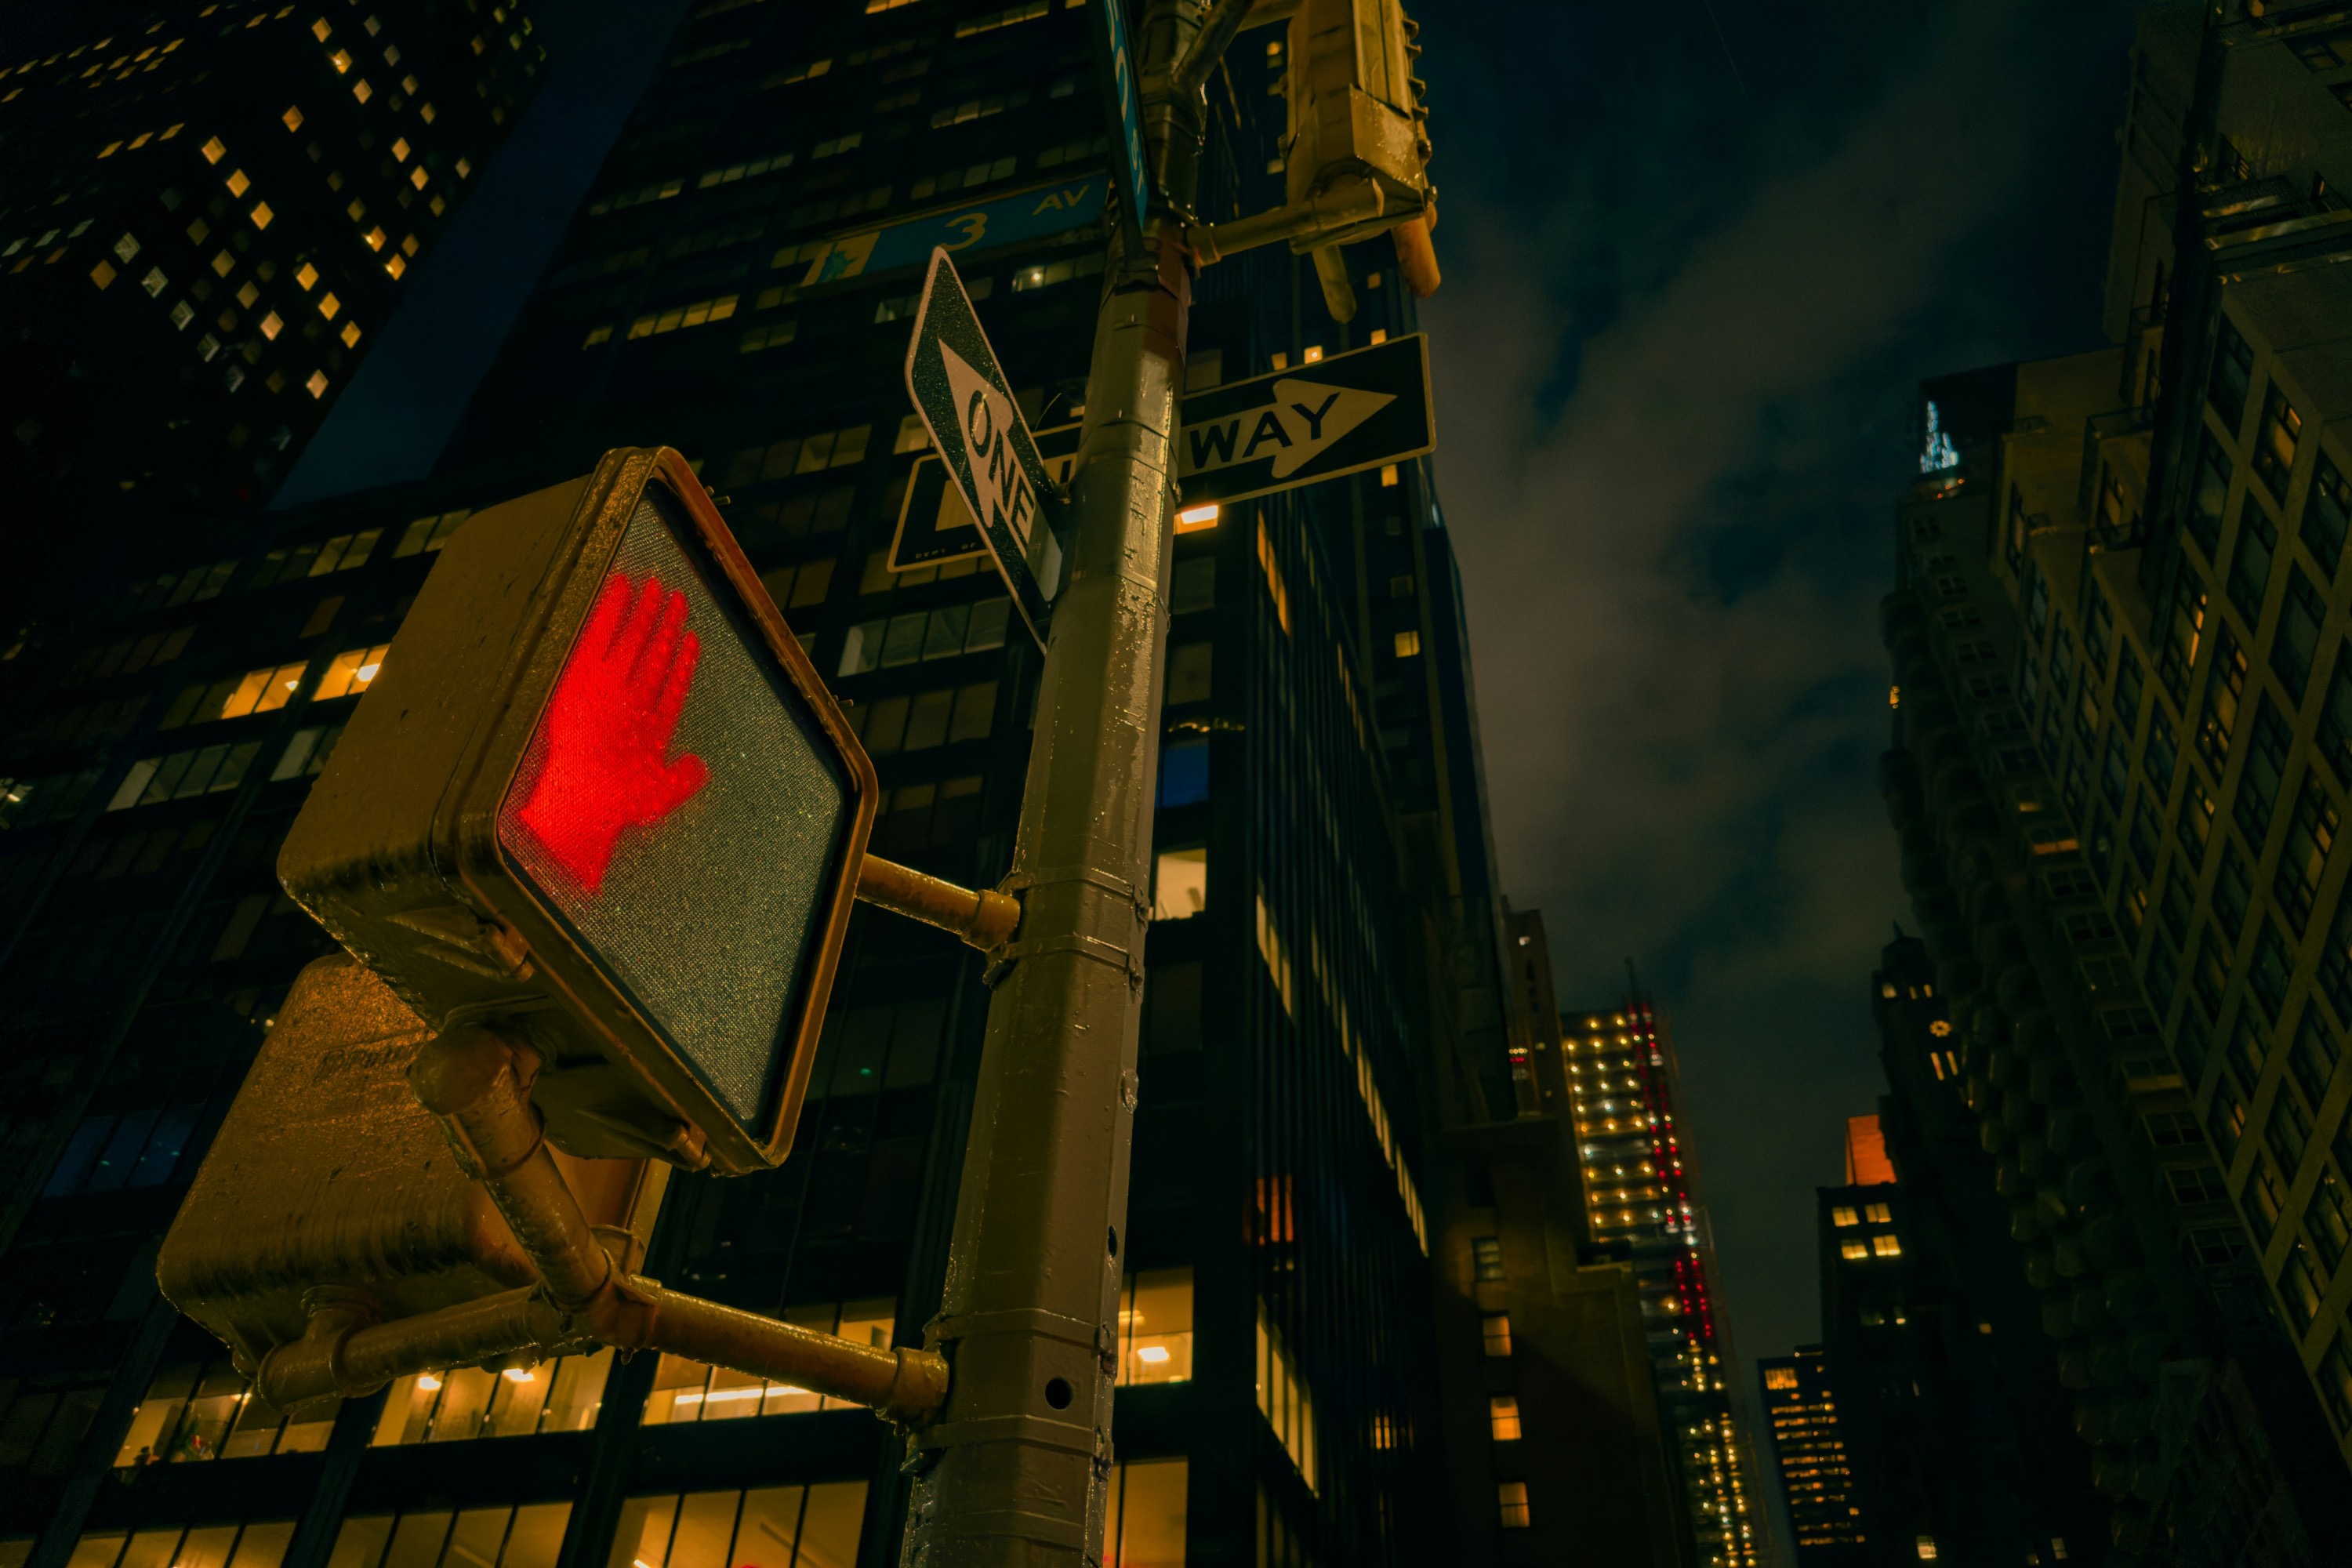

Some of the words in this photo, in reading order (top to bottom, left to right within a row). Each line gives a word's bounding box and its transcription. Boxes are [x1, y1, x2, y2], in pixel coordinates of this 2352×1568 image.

[944, 212, 989, 252] 3
[1032, 183, 1091, 217] AV
[1189, 392, 1342, 470] WAY
[968, 390, 1035, 552] ONE
